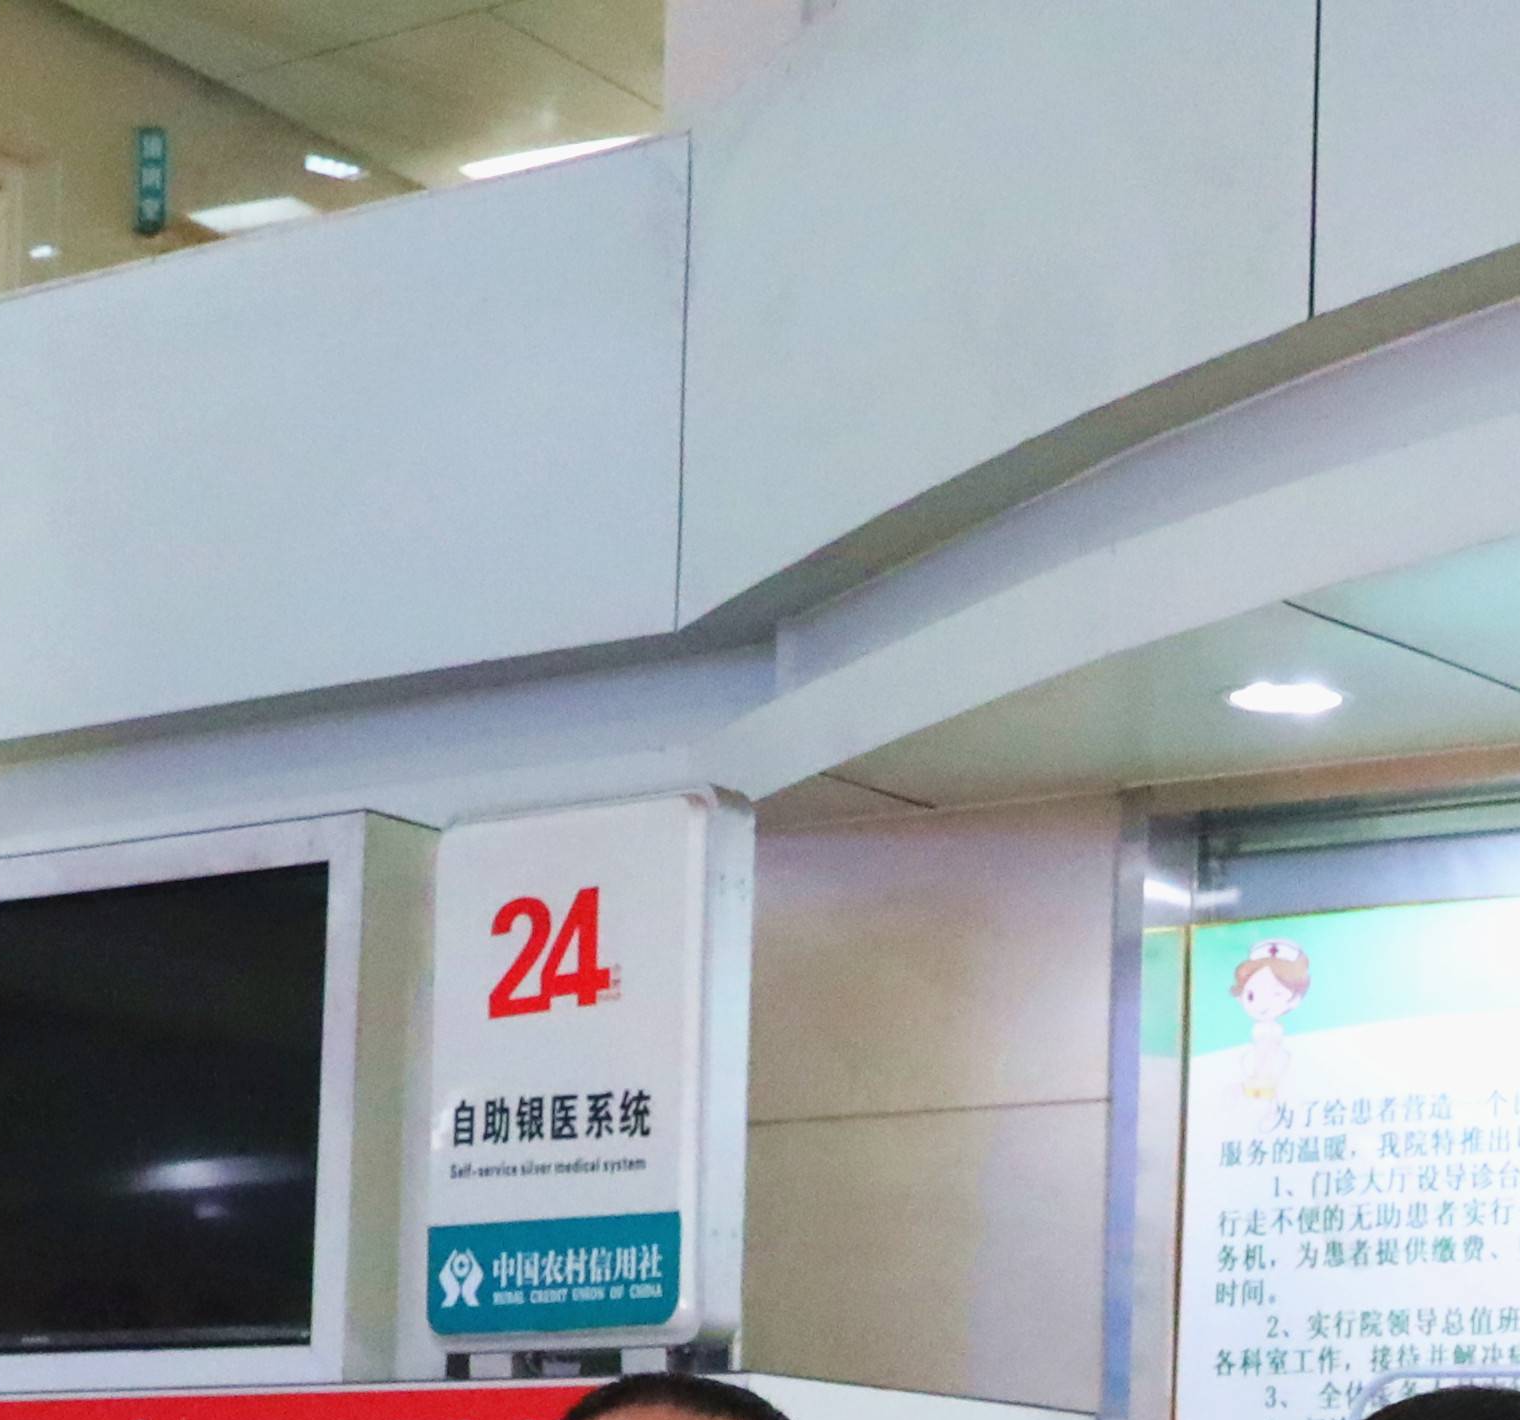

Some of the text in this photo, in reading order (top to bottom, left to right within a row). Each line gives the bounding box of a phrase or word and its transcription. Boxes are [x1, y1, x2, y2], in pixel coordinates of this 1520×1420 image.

[488, 885, 611, 1020] 24
[451, 1089, 652, 1148] 自助银医系统
[603, 1157, 647, 1176] system
[492, 1244, 664, 1288] 中国农村信用社
